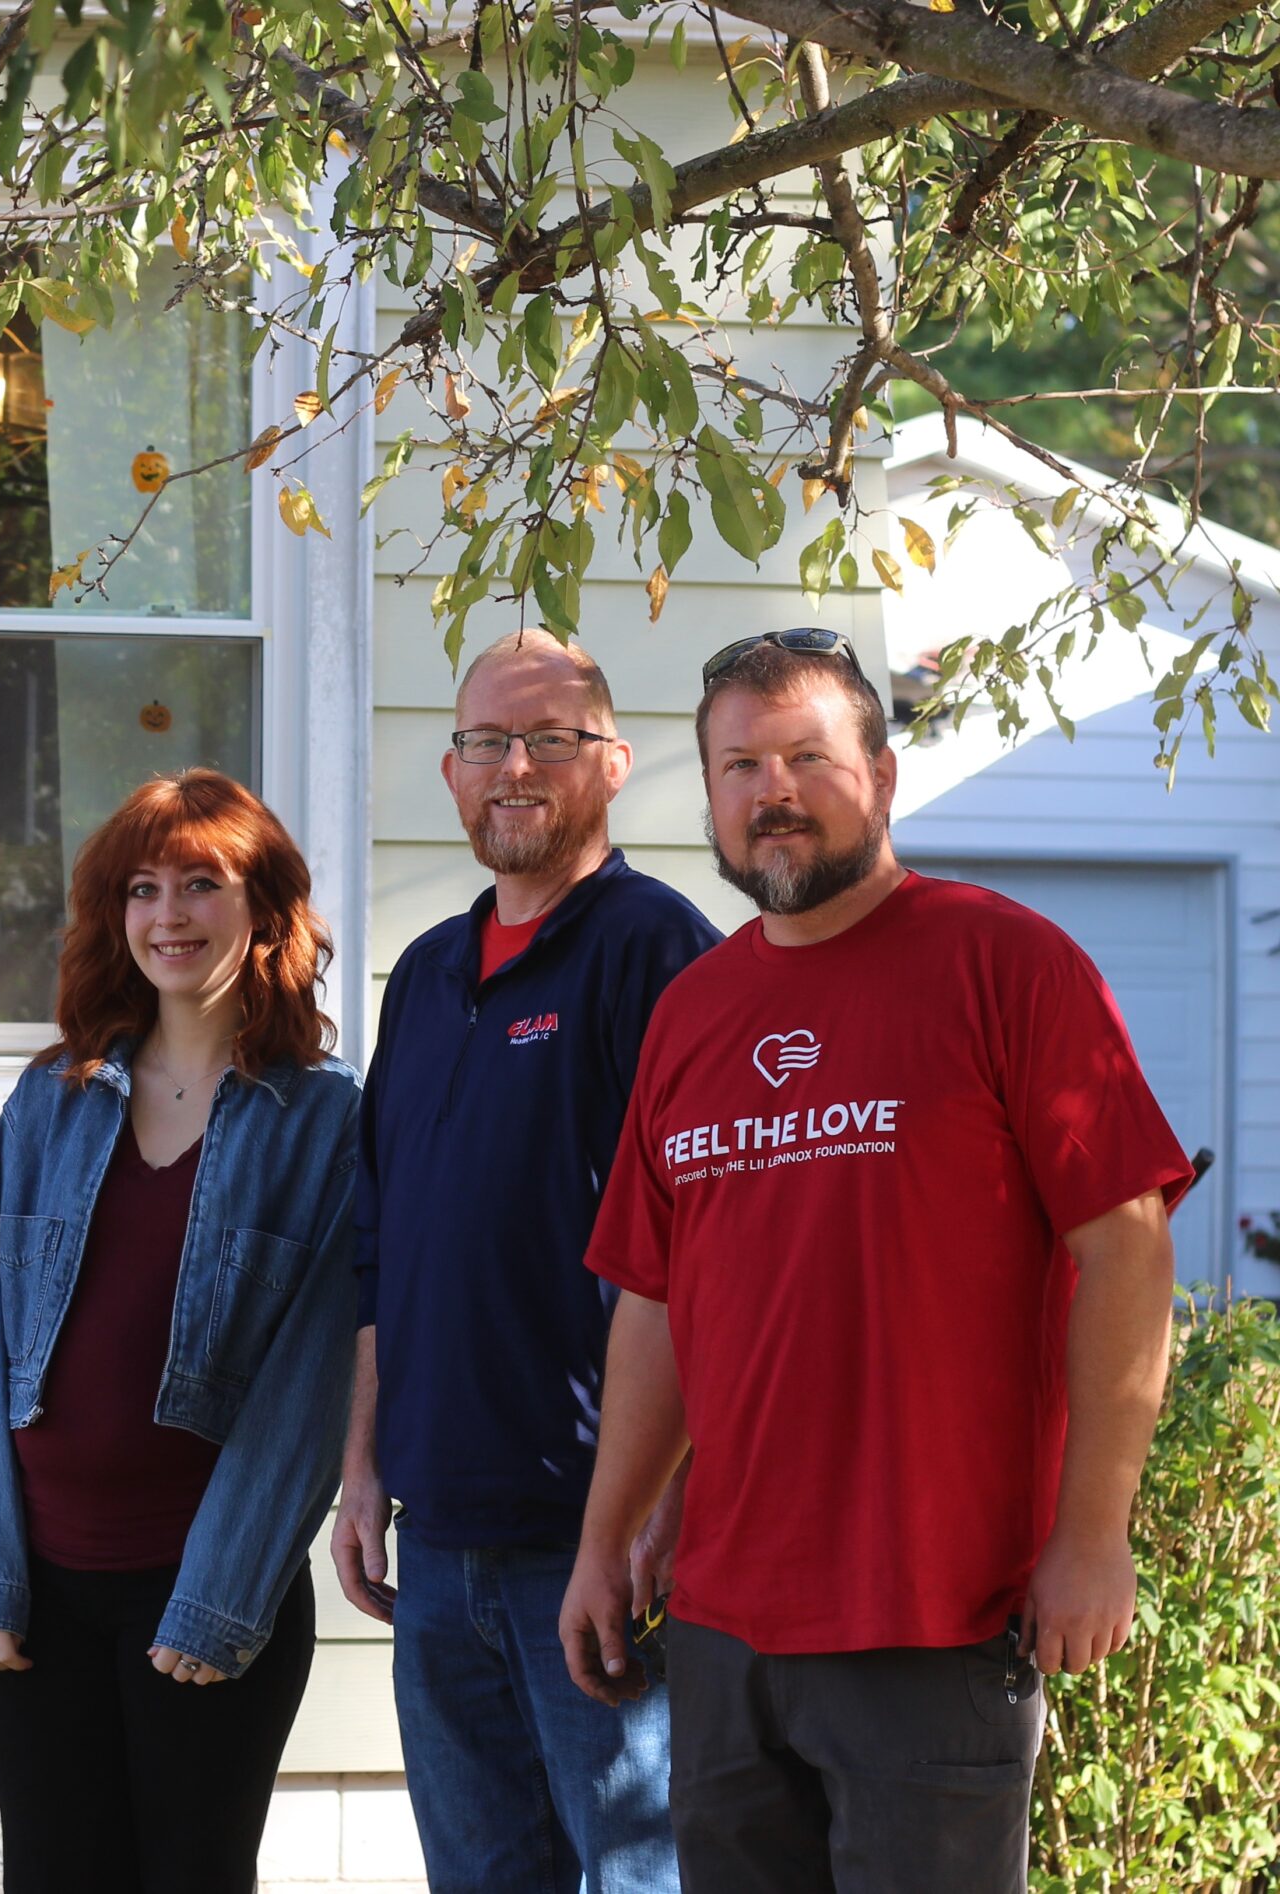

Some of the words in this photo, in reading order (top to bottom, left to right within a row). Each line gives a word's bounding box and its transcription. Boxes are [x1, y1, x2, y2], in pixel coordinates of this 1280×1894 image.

[507, 1012, 559, 1037] ELAM
[664, 1123, 730, 1170] FEEL
[733, 1111, 799, 1150] THE
[711, 1165, 725, 1178] by
[726, 1160, 745, 1173] THE
[767, 1149, 812, 1168] LENNOX
[815, 1141, 895, 1159] FOUNDATION
